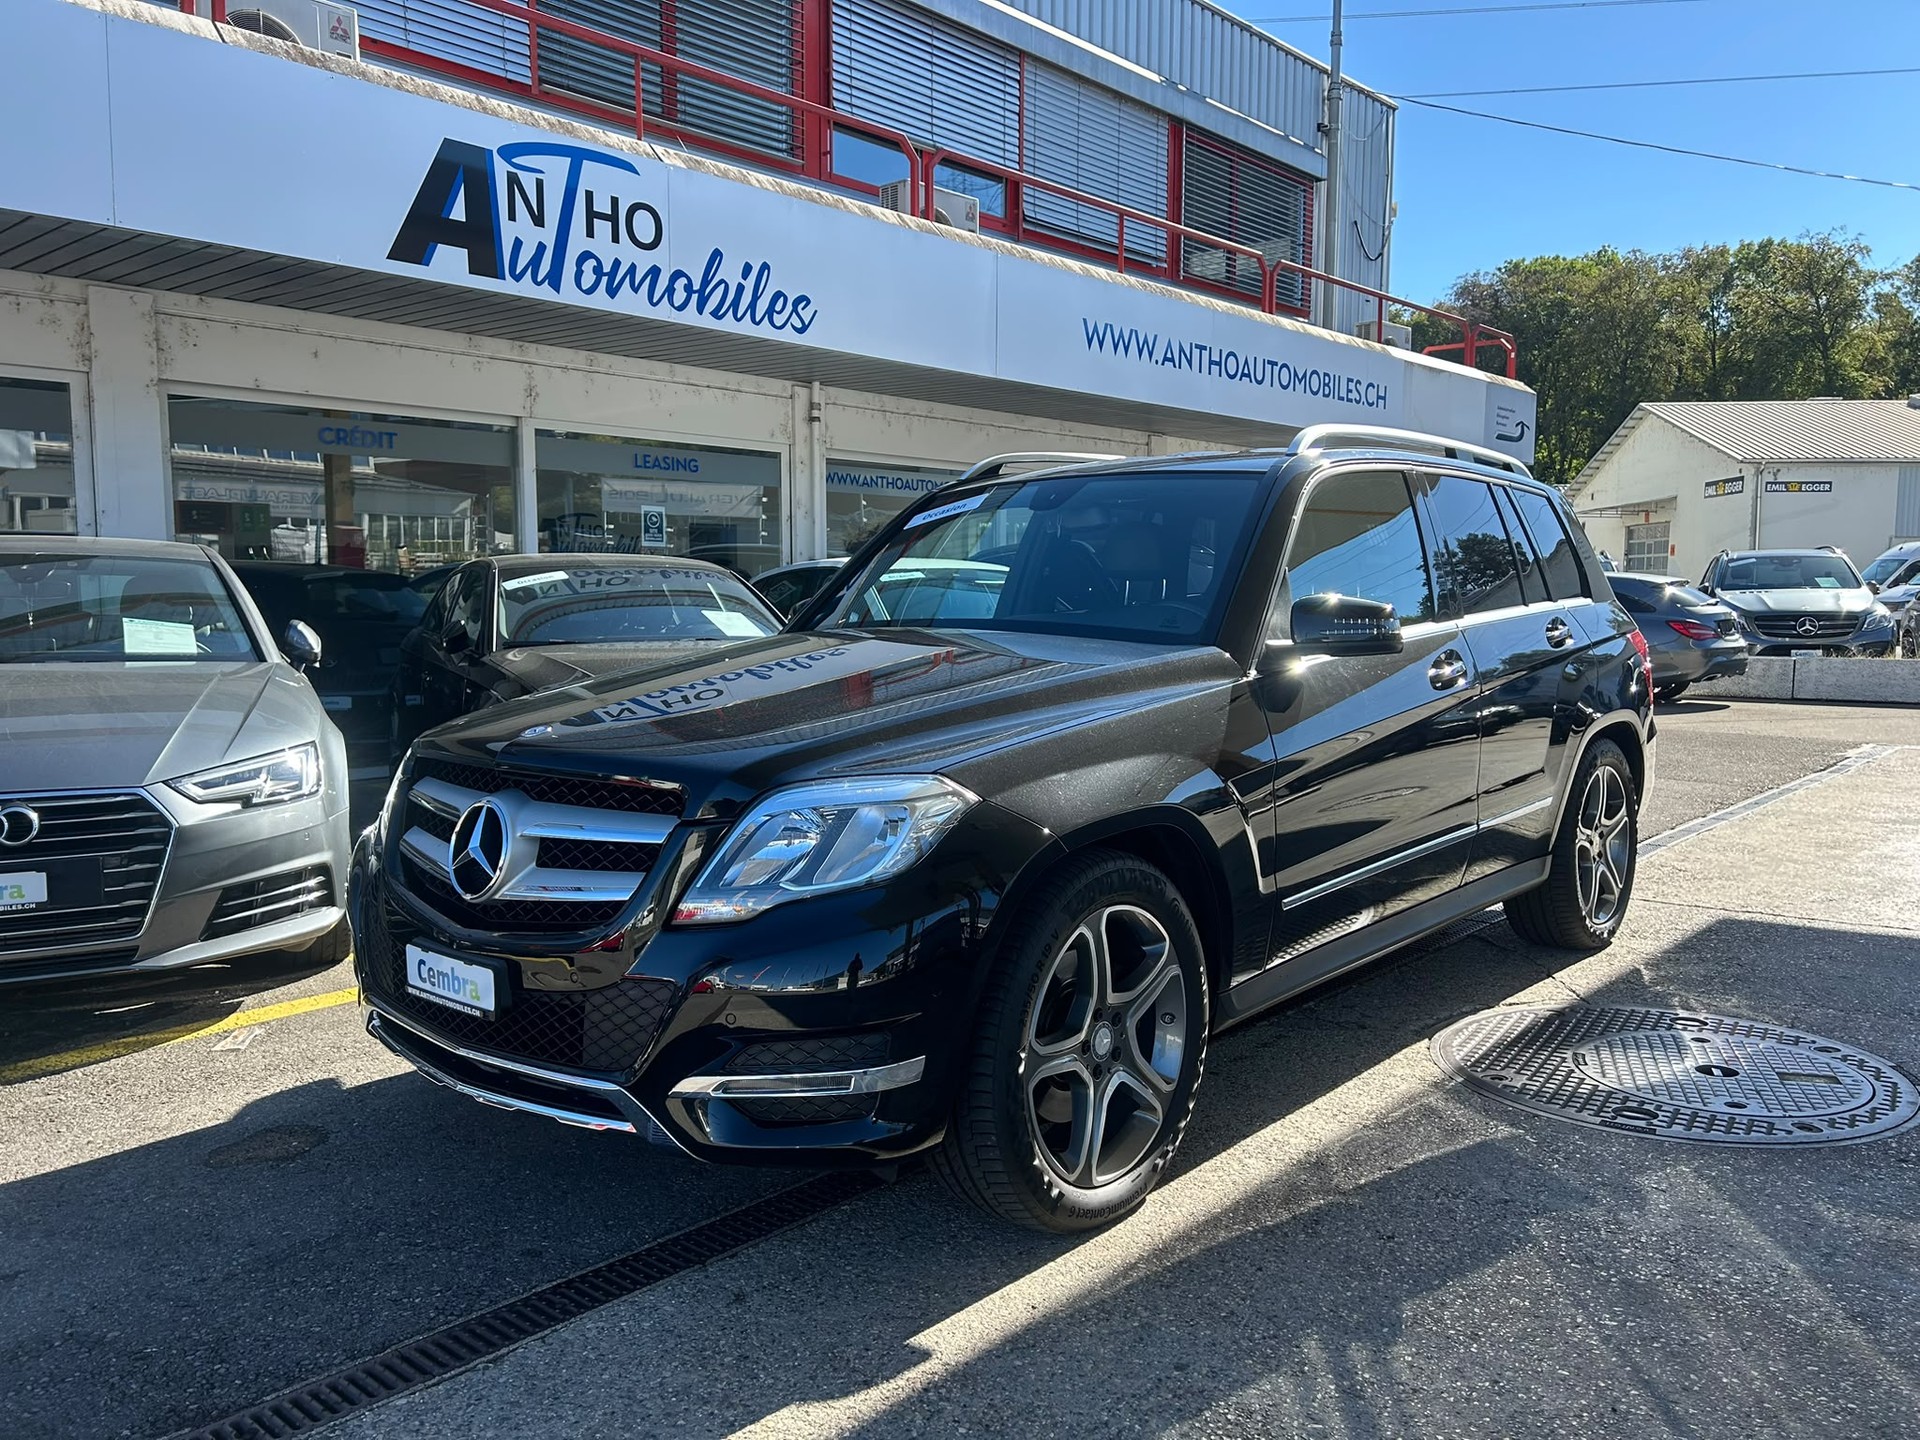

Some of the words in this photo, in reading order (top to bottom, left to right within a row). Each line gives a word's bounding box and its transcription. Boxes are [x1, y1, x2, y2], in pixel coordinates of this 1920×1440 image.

[1082, 317, 1388, 410] WWW.ANTHOAUTOMOBILES.CH
[317, 425, 398, 449] CRÉDIT
[634, 453, 700, 473] LEASING
[1705, 486, 1717, 497] EMIL
[1725, 480, 1743, 493] EGGER
[1766, 483, 1787, 491] EMIL
[1801, 483, 1831, 491] EGGER
[922, 502, 968, 521] Occasion
[417, 958, 480, 1002] Cembra
[407, 986, 482, 1017] WWW.ANTHOAUTOMOBILES.CH
[1068, 1205, 1076, 1218] 6
[1075, 1183, 1148, 1221] PremiumContact
